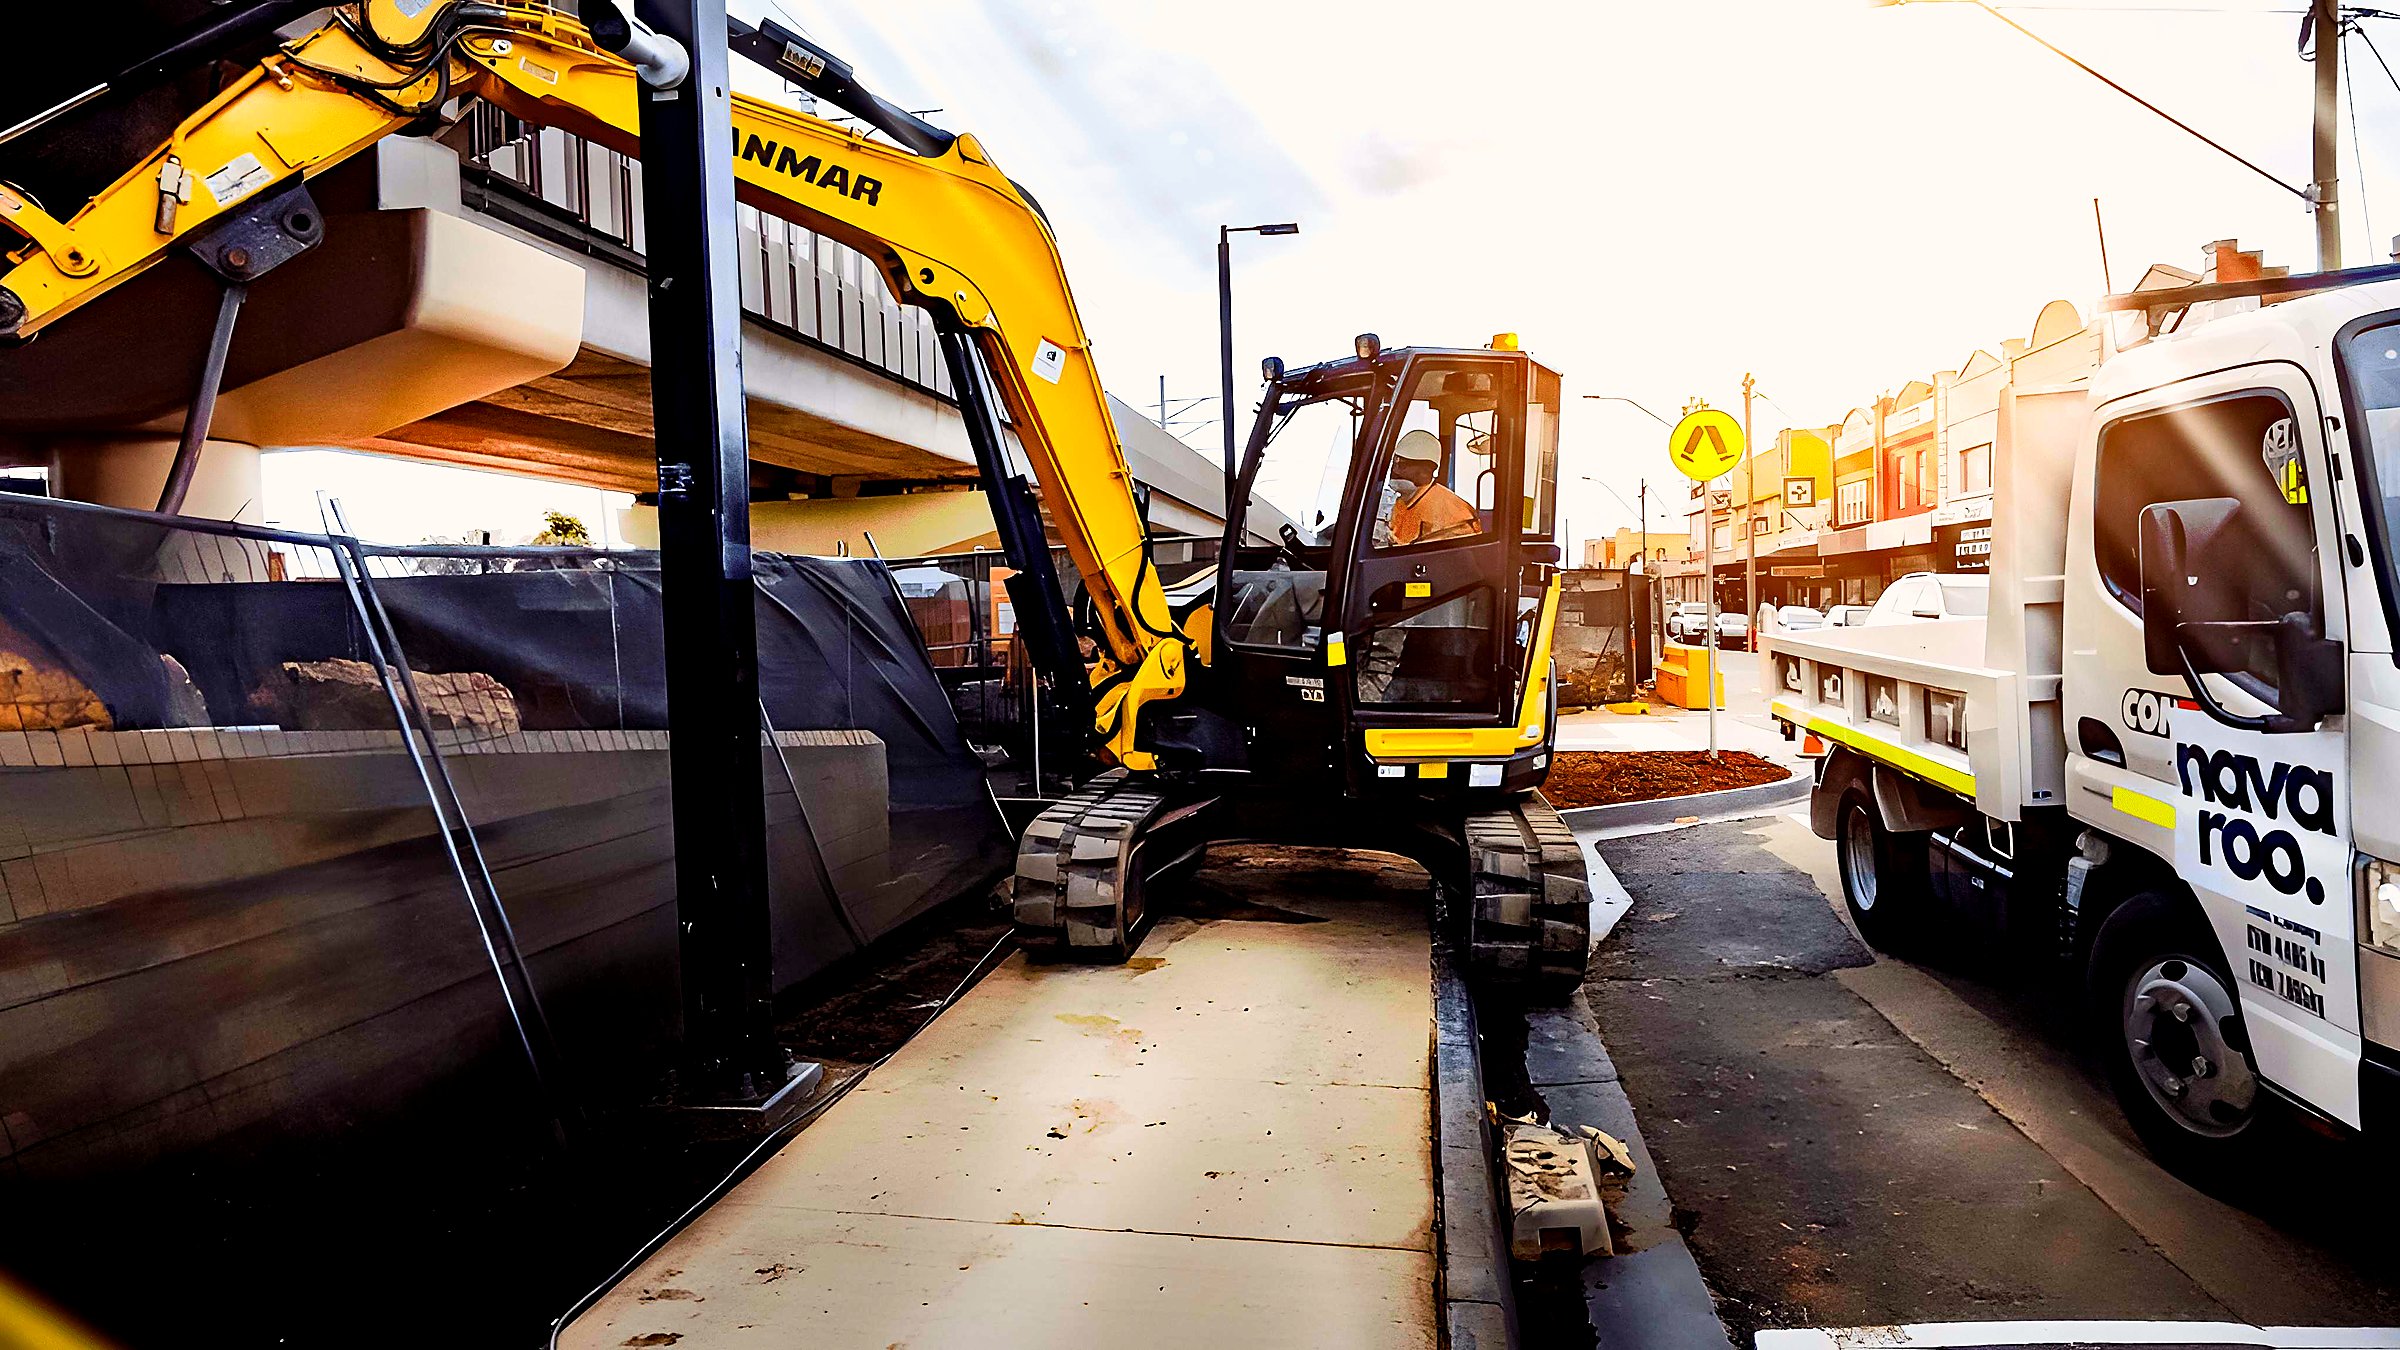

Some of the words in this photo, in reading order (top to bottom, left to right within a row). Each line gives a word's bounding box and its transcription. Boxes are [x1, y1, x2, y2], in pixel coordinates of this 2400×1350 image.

[732, 127, 883, 207] NMAR
[2177, 742, 2338, 838] nava
[2199, 809, 2326, 906] roo.
